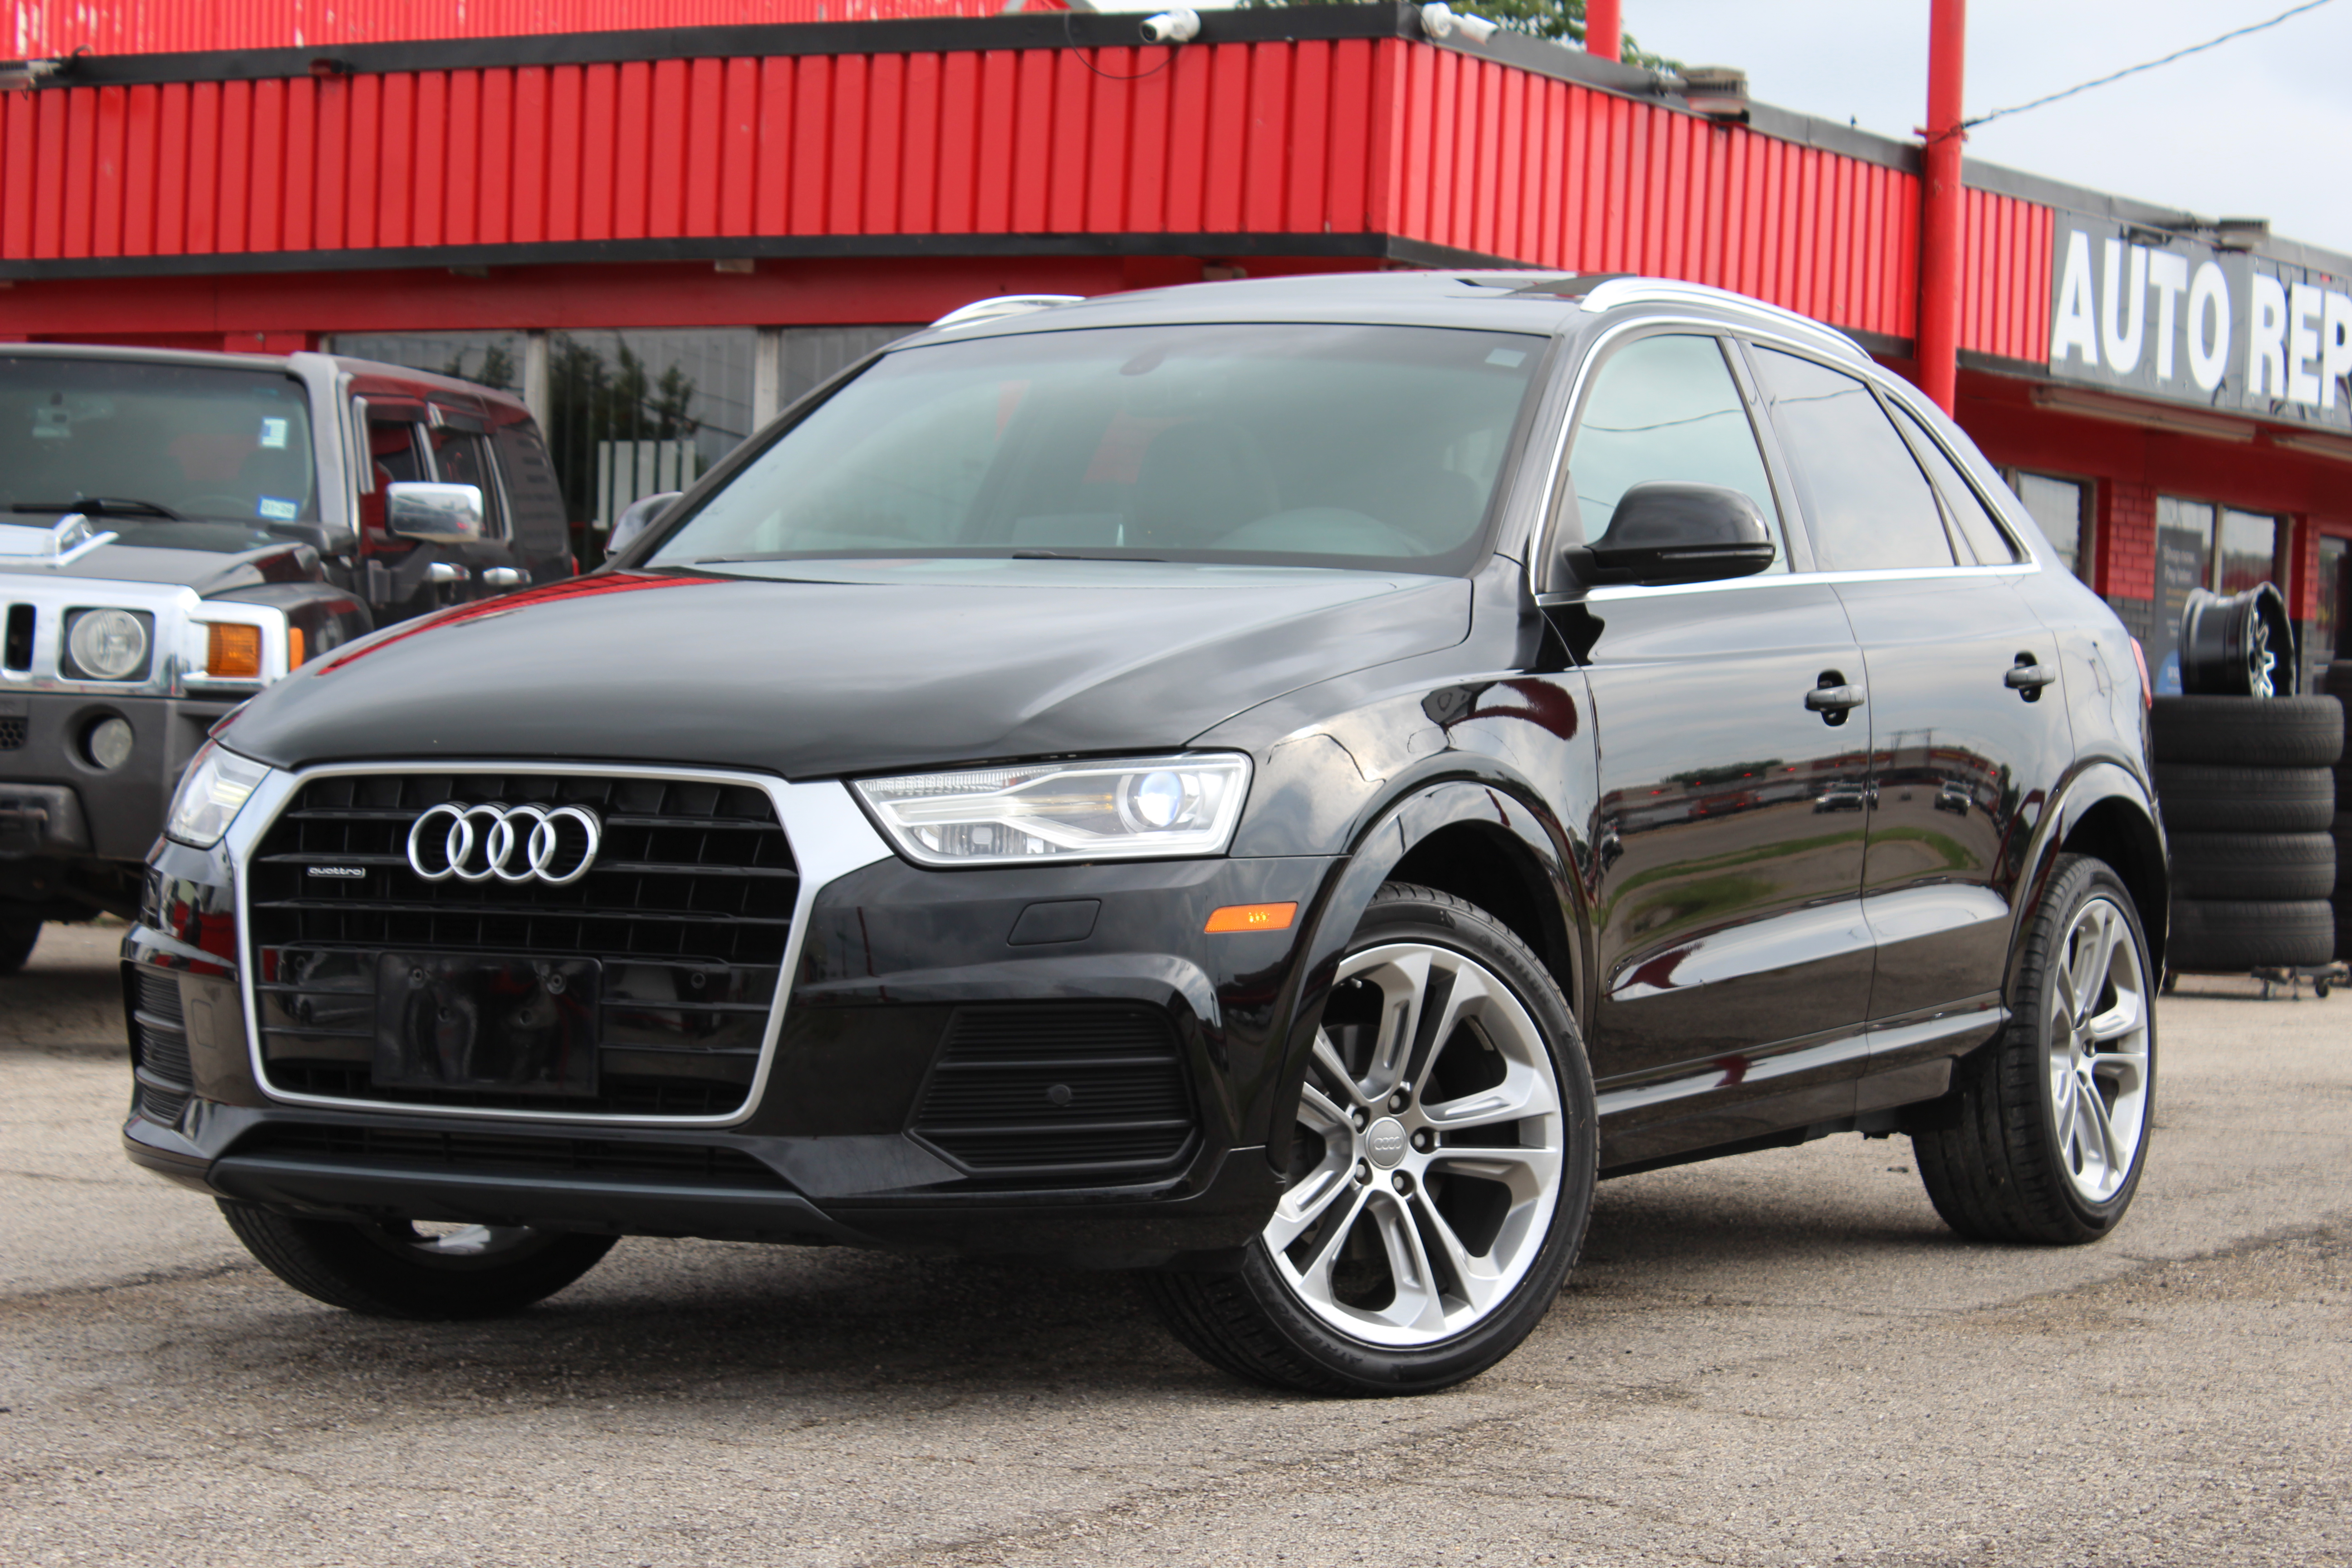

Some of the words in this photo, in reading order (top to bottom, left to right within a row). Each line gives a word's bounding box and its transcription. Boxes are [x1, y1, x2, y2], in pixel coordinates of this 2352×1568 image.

[2051, 229, 2230, 392] AUTO
[2248, 272, 2352, 409] REP
[309, 867, 362, 875] quattro
[1494, 944, 1551, 1005] SAILUN
